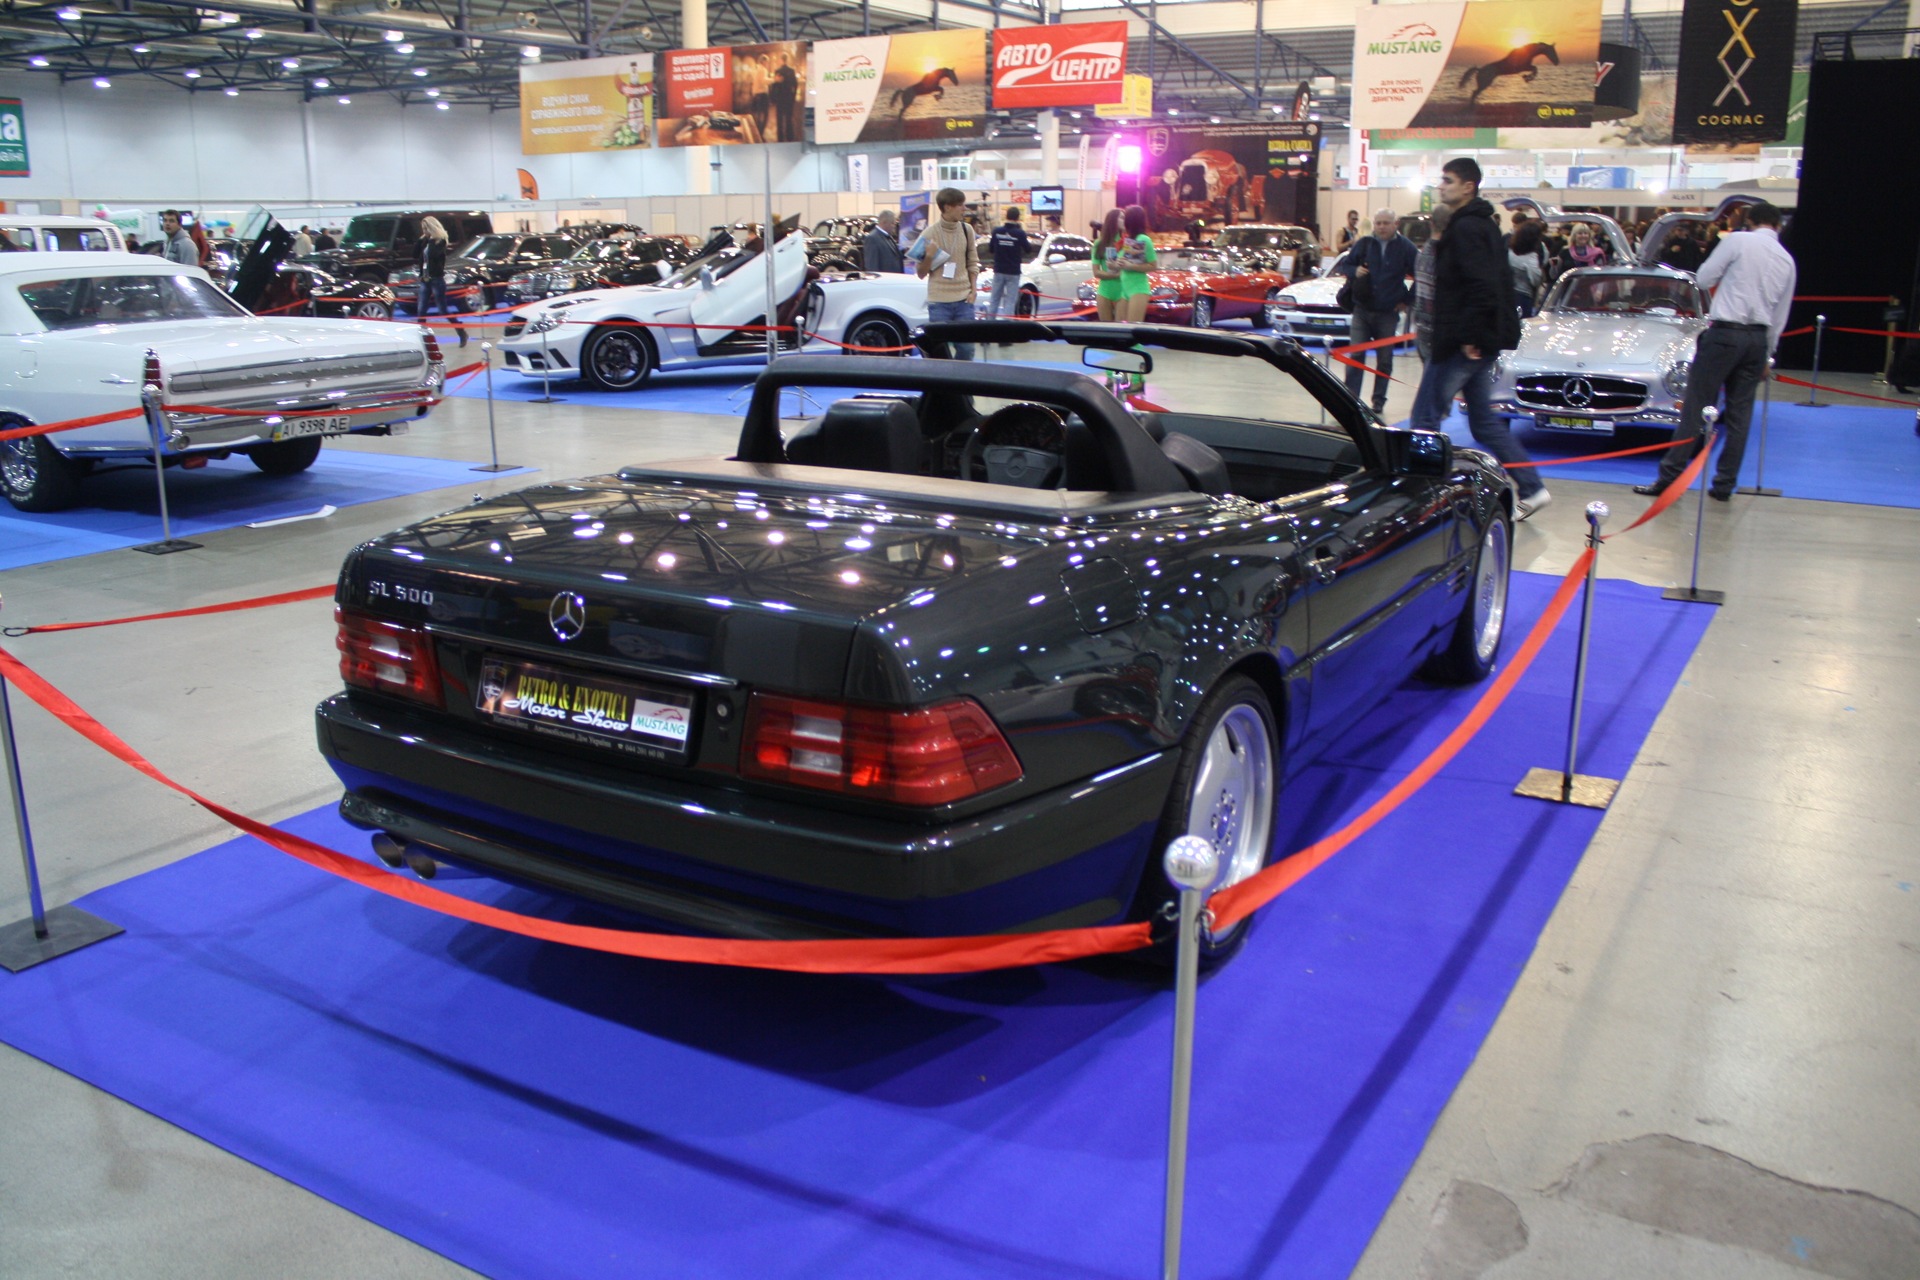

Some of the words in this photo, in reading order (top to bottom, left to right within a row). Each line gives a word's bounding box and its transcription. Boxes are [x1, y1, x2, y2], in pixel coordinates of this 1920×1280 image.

[997, 42, 1051, 69] АВТО
[1367, 40, 1443, 55] MUSTANG
[823, 69, 876, 82] MUSTANG
[1050, 57, 1121, 81] ЦЕНТР
[1697, 114, 1765, 126] COGNAC
[300, 418, 326, 434] 9398
[328, 416, 348, 432] AE
[368, 580, 390, 597] SL
[395, 585, 434, 606] 500
[517, 675, 557, 707] RETRO
[558, 683, 570, 710] &
[573, 686, 629, 722] EXOTICA
[503, 695, 567, 720] Motor
[572, 708, 629, 732] Show
[634, 716, 686, 735] MUSTANG
